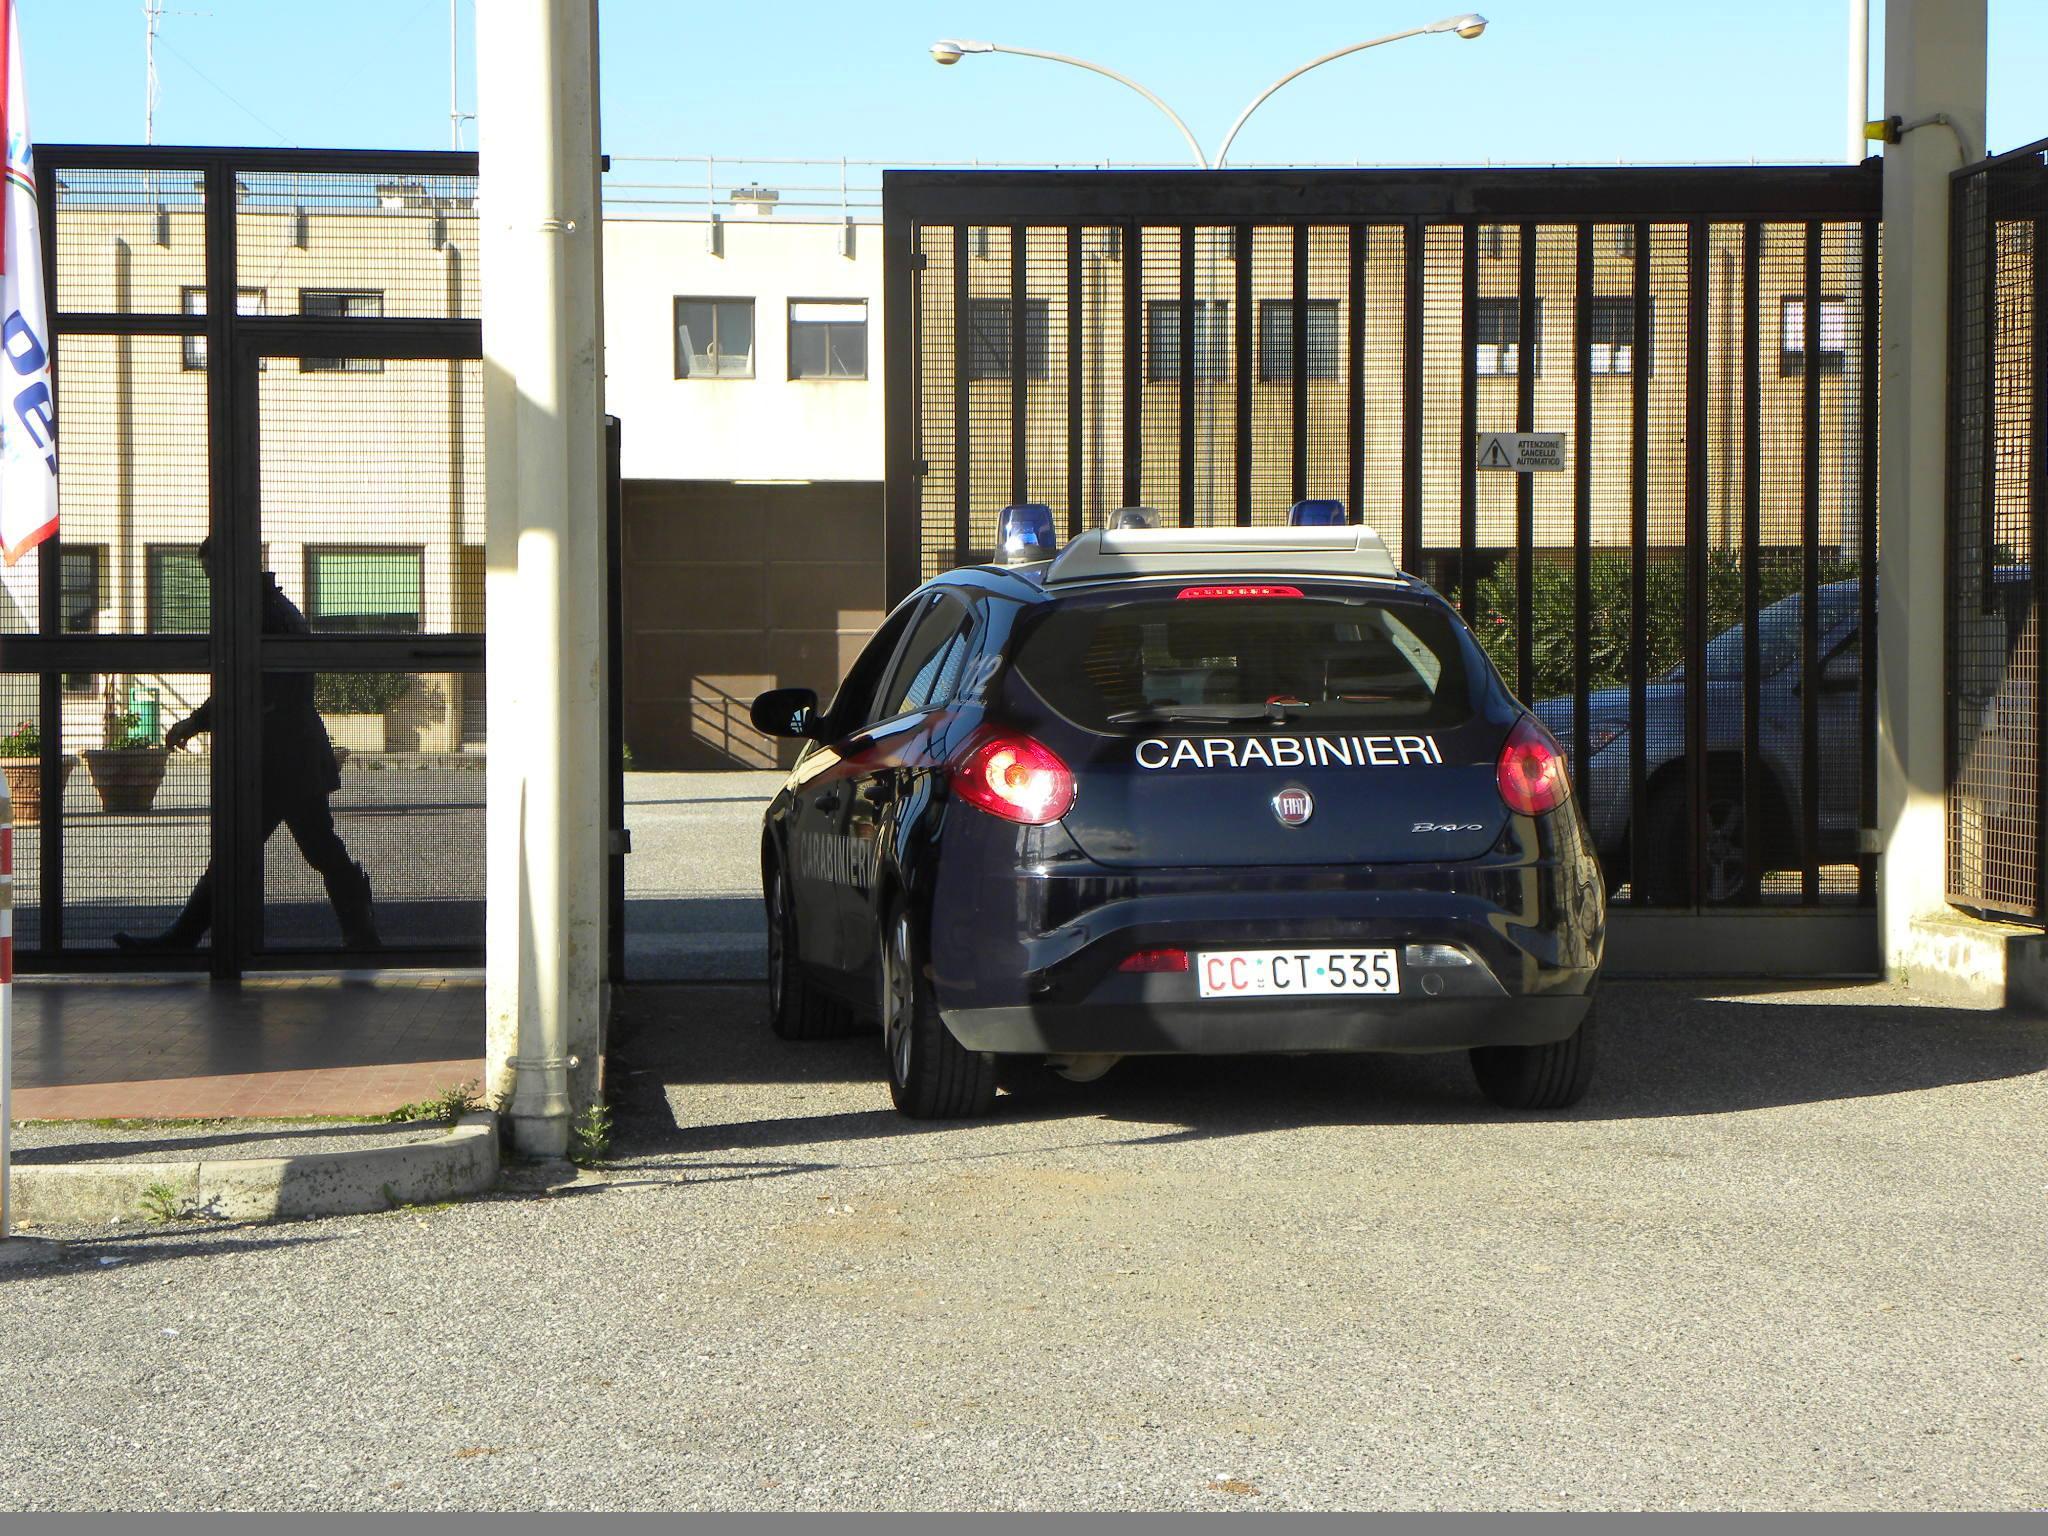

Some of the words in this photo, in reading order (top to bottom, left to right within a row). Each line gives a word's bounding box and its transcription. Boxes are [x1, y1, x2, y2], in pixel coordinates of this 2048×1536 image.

[1518, 440, 1560, 449] ATTENZIONE
[1521, 449, 1556, 457] CANCELLO
[1516, 457, 1560, 465] AUTOMATICO
[1135, 735, 1443, 769] CARABINIERI
[1283, 797, 1305, 815] FIAT
[1411, 822, 1483, 833] Bravo
[800, 832, 872, 888] CARABINIERI
[1207, 957, 1248, 991] CC
[1271, 955, 1311, 989] CT
[1328, 954, 1392, 988] 535
